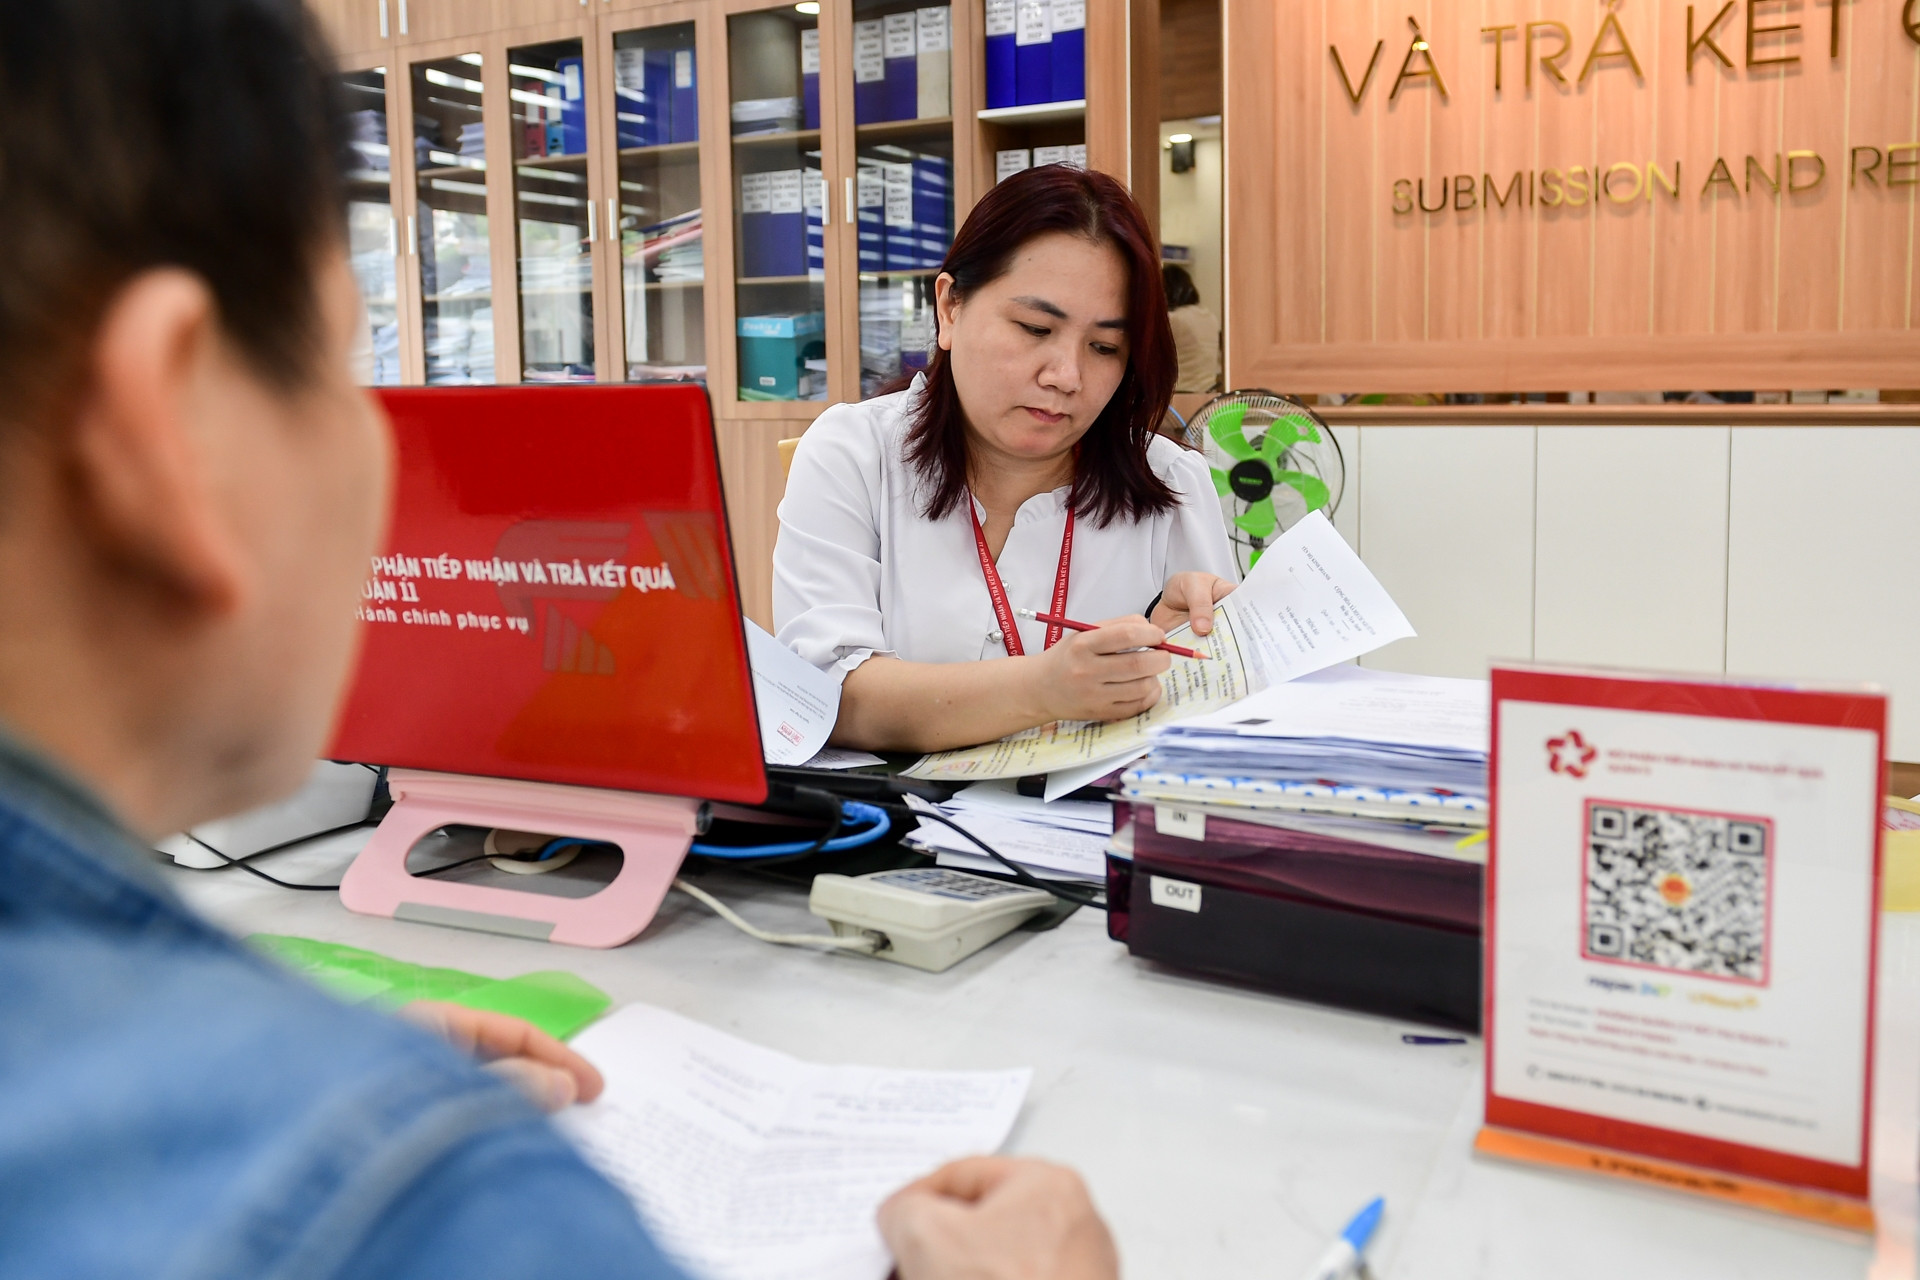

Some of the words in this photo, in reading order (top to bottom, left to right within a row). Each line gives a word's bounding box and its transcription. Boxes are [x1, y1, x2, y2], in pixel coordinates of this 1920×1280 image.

[1329, 15, 1449, 104] VÀ
[1392, 161, 1680, 214] SUBMISSION
[1702, 150, 1826, 195] AND
[370, 553, 421, 582] PHẬN
[421, 552, 462, 580] TIẾP
[464, 557, 519, 587] NHẬN
[519, 558, 548, 584] VÀ
[547, 558, 588, 586] TRẢ
[587, 558, 627, 588] KẾT
[630, 562, 676, 593] QUẢ
[360, 577, 398, 604] UẬN
[399, 580, 421, 602] 11
[402, 608, 452, 627] chính
[456, 611, 501, 632] phục
[505, 616, 529, 635] vụ
[1173, 812, 1188, 822] IN
[1165, 884, 1195, 900] OUT
